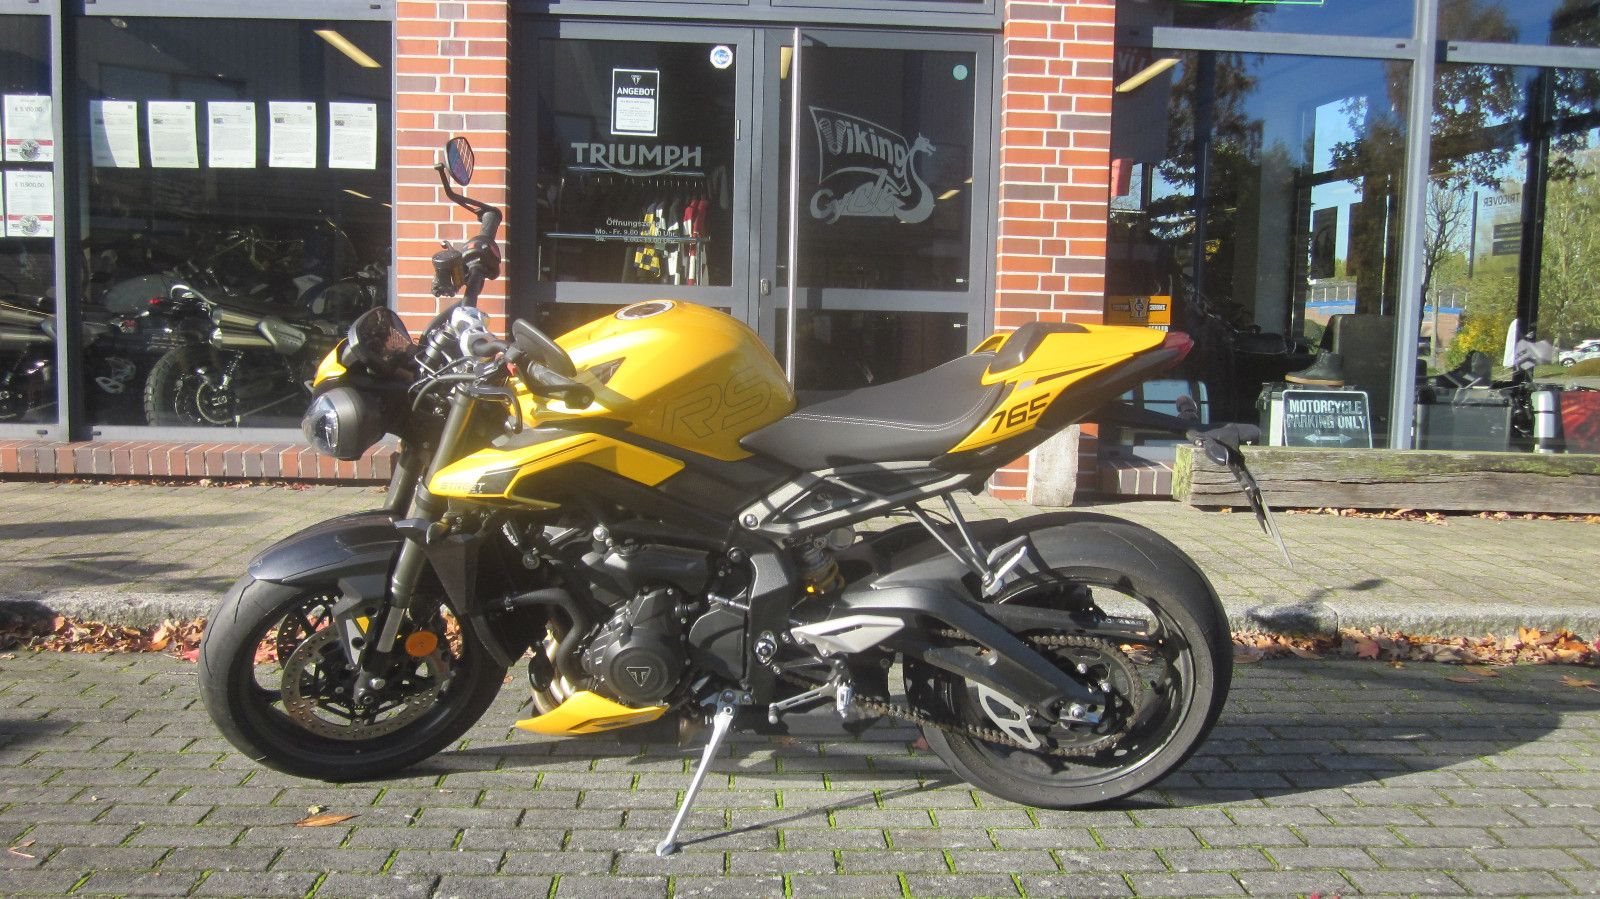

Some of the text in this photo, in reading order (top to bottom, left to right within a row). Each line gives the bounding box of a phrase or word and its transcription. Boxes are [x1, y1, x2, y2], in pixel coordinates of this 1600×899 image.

[617, 87, 656, 96] ANGEBOT
[571, 142, 702, 176] TRIUMPH
[819, 117, 908, 178] Viking
[606, 217, 662, 228] Öffnungsz
[661, 366, 772, 438] RS
[991, 392, 1051, 434] 765
[1289, 399, 1363, 415] MOTORCYCLE
[1286, 413, 1367, 430] PARKING ONLY
